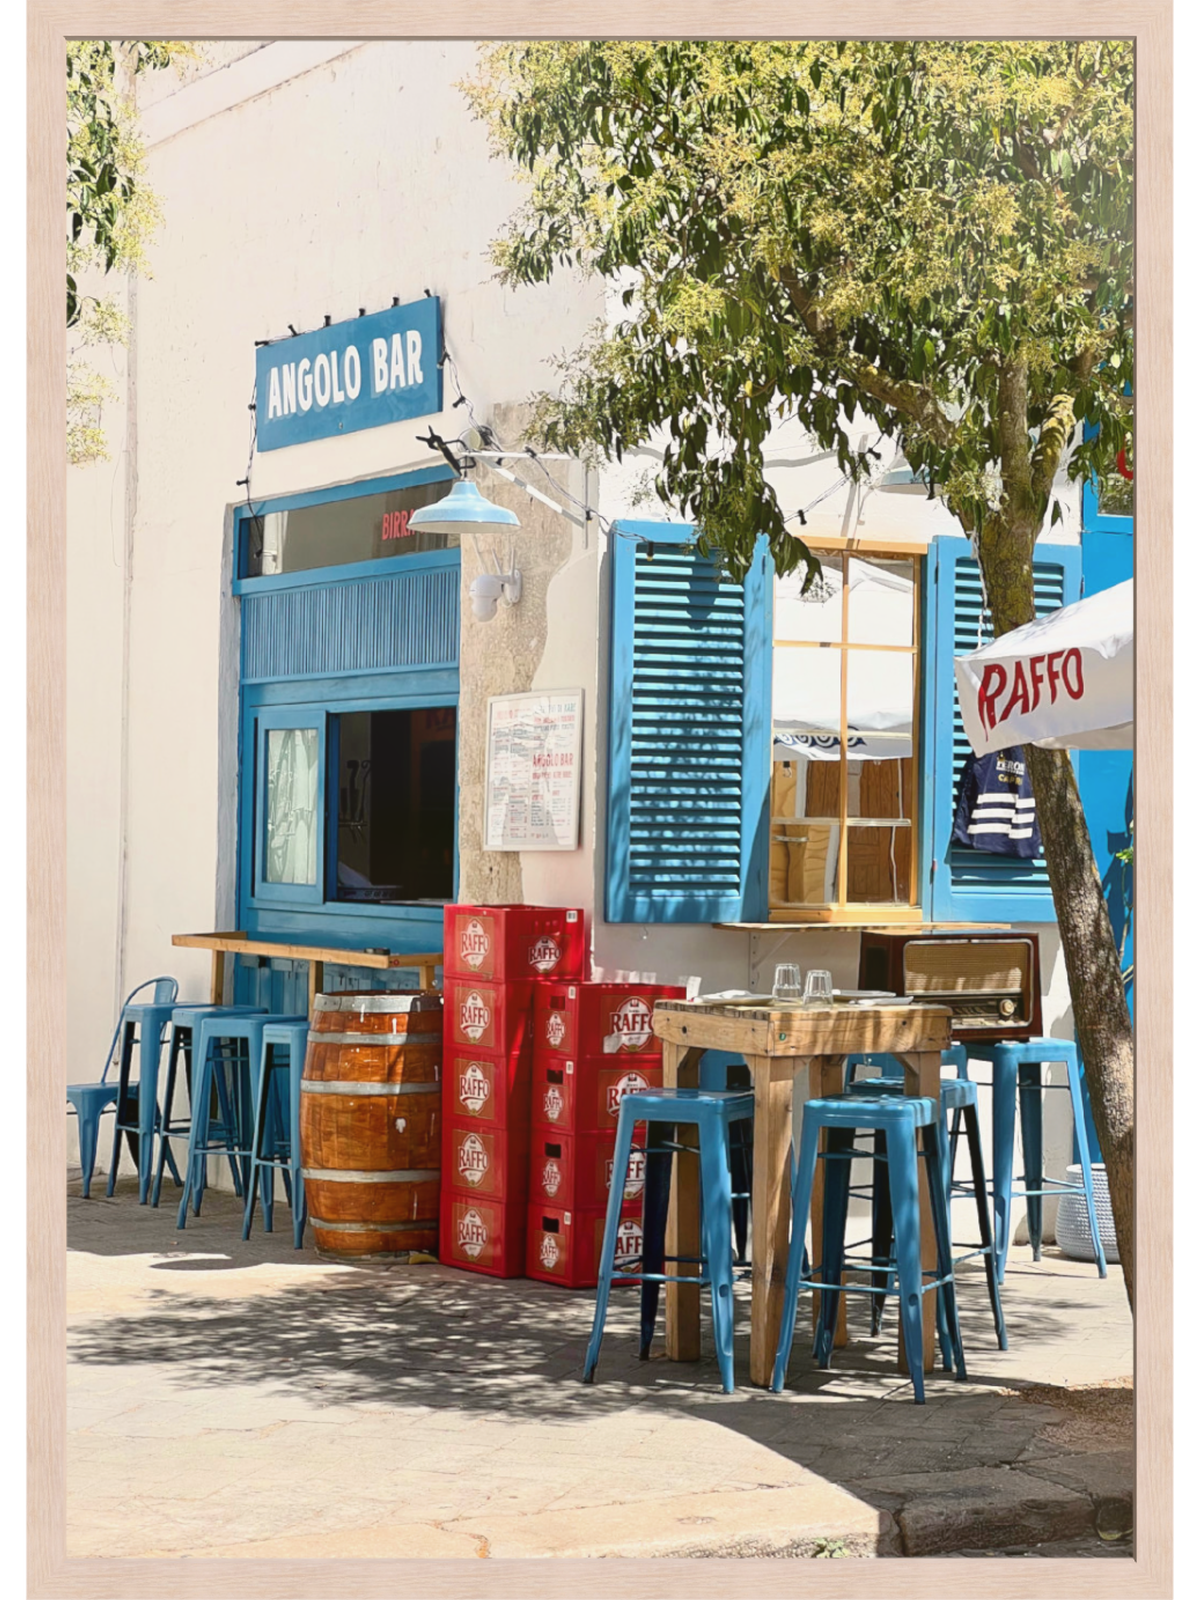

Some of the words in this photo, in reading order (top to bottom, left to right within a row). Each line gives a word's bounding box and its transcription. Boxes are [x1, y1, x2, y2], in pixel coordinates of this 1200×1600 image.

[268, 345, 362, 419] ANGOLO
[373, 330, 424, 393] BAR
[978, 647, 1084, 742] RAFFO
[461, 932, 490, 953] RAFFO
[529, 947, 561, 962] RAFFO
[461, 1004, 490, 1025] RAFFO
[460, 1076, 489, 1097] RAFFO
[459, 1147, 488, 1169] RAFFO
[458, 1221, 487, 1243] RAFFO
[615, 1236, 643, 1255] AFF
